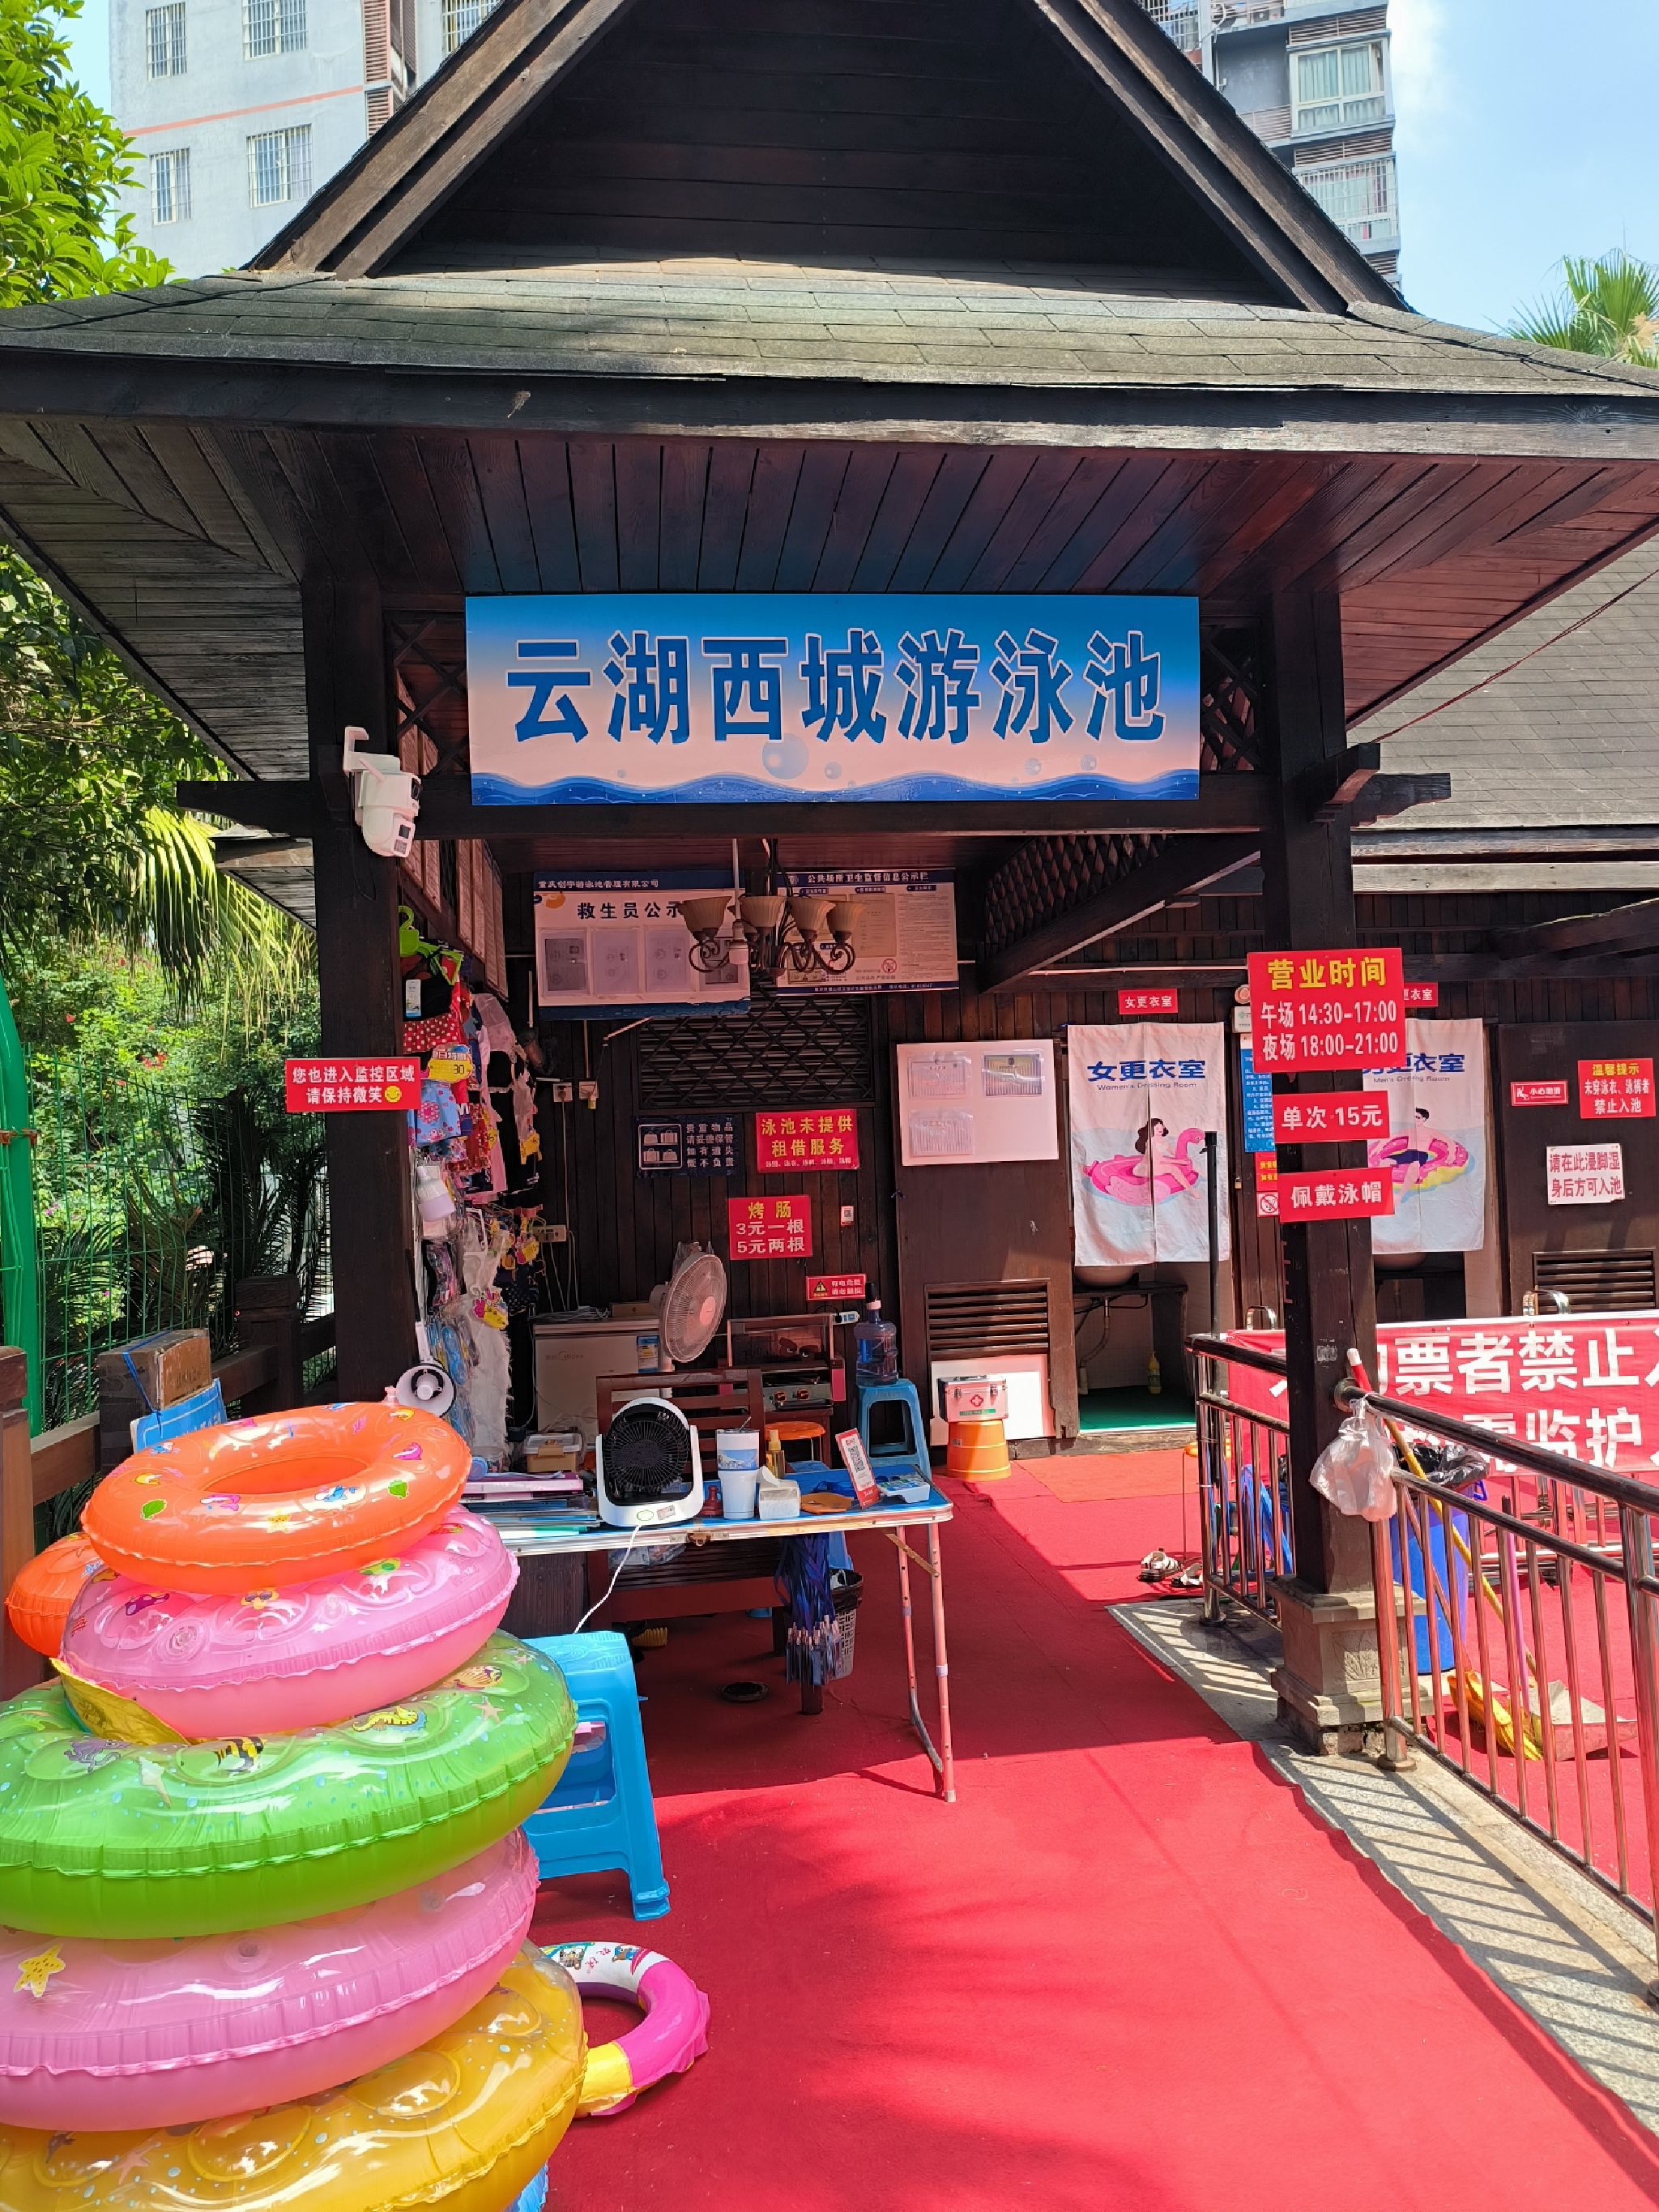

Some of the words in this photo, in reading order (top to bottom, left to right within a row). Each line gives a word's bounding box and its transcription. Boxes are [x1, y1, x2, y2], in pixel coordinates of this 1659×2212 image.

[505, 627, 1166, 745] 云湖西城游泳池
[1268, 957, 1386, 990] 营业时间
[1125, 996, 1172, 1008] 女更衣室
[1261, 1001, 1294, 1029] 午场
[1299, 1000, 1397, 1025] 14:30-17:00
[1262, 1033, 1295, 1061] 夜场
[1301, 1031, 1398, 1057] 18:00-21:00
[292, 1065, 415, 1083] 您也进入监控区域
[1087, 1058, 1205, 1082] 女更衣室
[1593, 1062, 1639, 1076] 温馨提示
[306, 1086, 382, 1104] 请保持微笑
[1594, 1097, 1642, 1115] 禁止入池
[761, 1115, 853, 1136] 泳池未提供
[1282, 1106, 1327, 1130] 单次
[1335, 1104, 1384, 1128] 15元
[771, 1137, 845, 1157] 租借服务
[1550, 1151, 1620, 1172] 请在此浸脚湿
[1290, 1181, 1382, 1209] 佩戴泳帽
[1552, 1176, 1622, 1198] 身后方可入池
[736, 1218, 805, 1235] 3元一根
[737, 1236, 805, 1254] 5元两根
